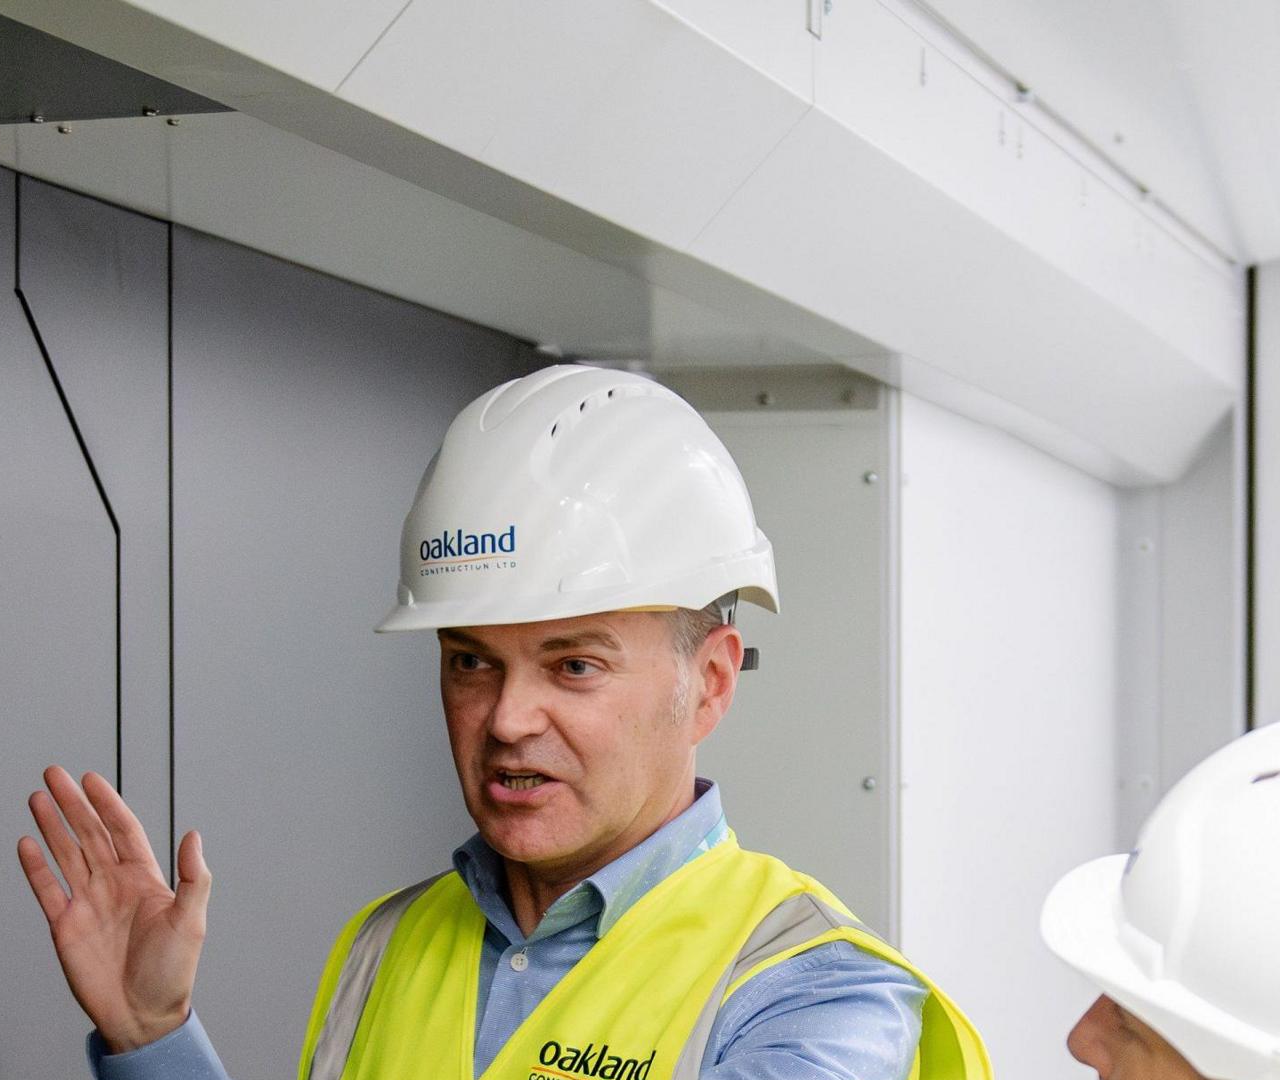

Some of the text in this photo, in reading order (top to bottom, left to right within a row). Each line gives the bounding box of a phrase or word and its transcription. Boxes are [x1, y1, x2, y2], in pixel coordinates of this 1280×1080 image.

[420, 525, 515, 561] oakland
[420, 561, 517, 577] CONSTRUCTION LTD
